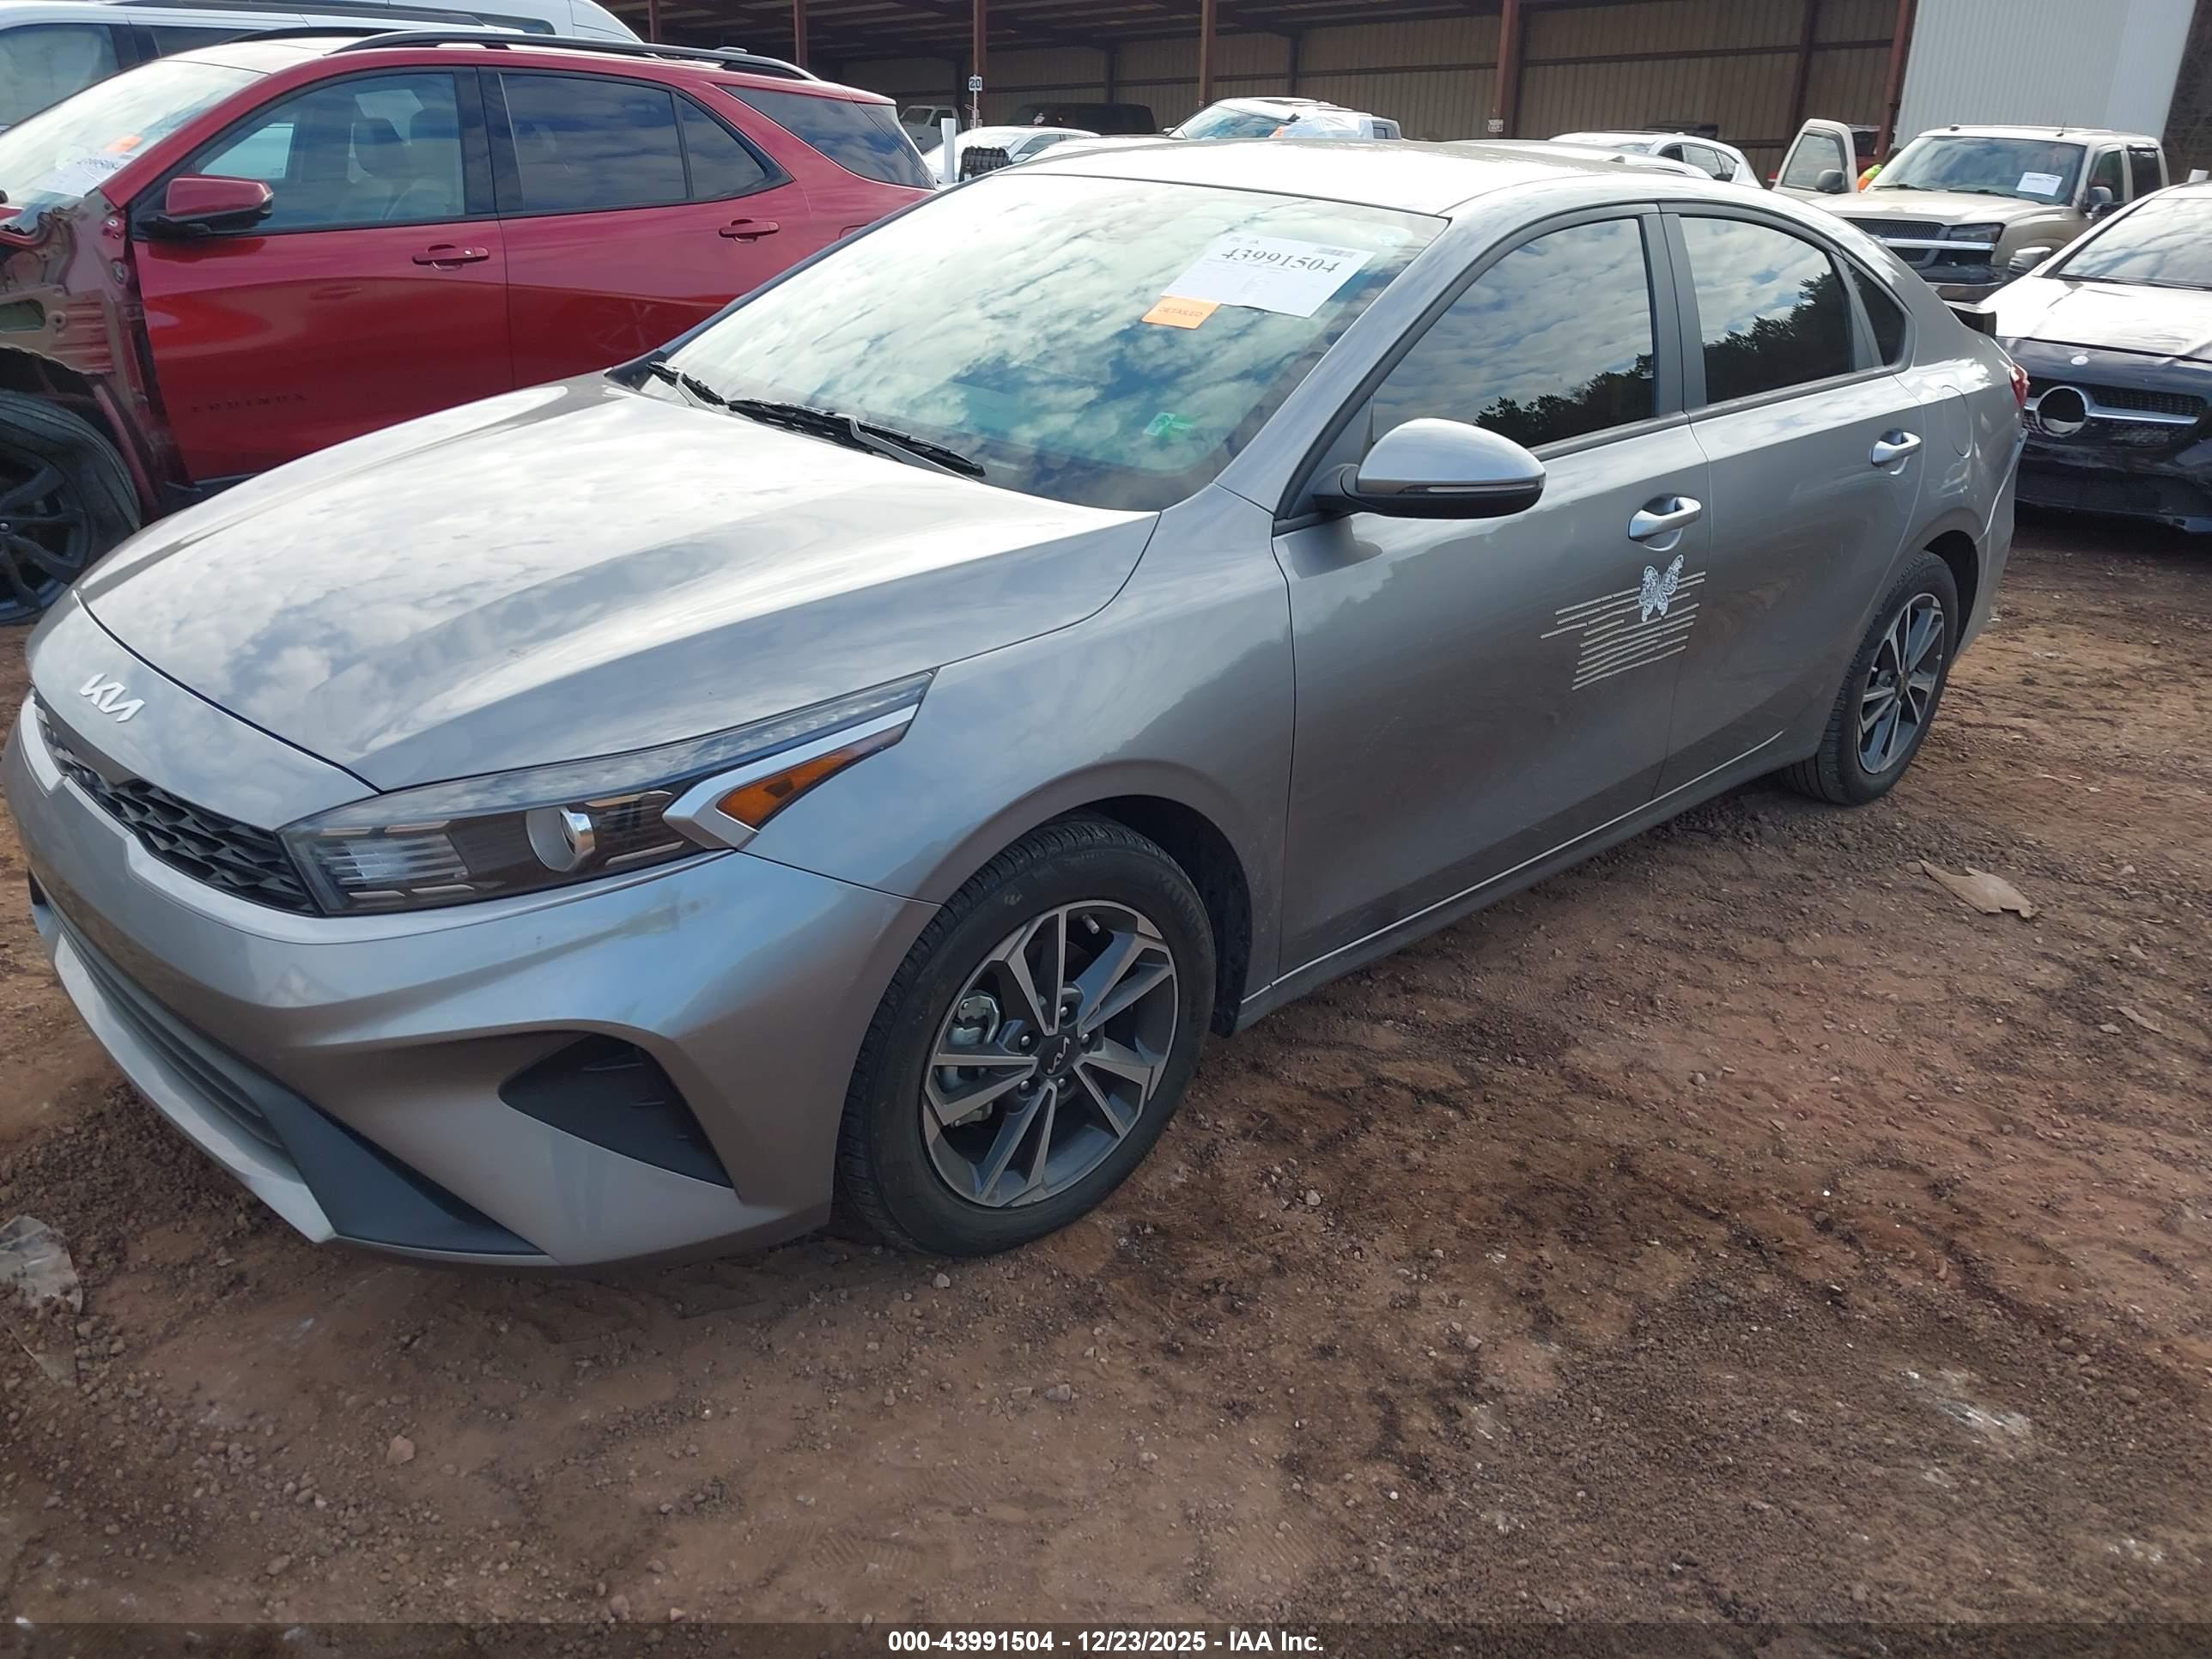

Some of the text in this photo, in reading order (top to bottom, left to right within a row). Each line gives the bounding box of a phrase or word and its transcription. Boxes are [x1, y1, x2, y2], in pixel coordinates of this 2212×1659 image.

[969, 78, 981, 89] 20
[1221, 247, 1340, 274] 43991504
[78, 672, 146, 724] KIA
